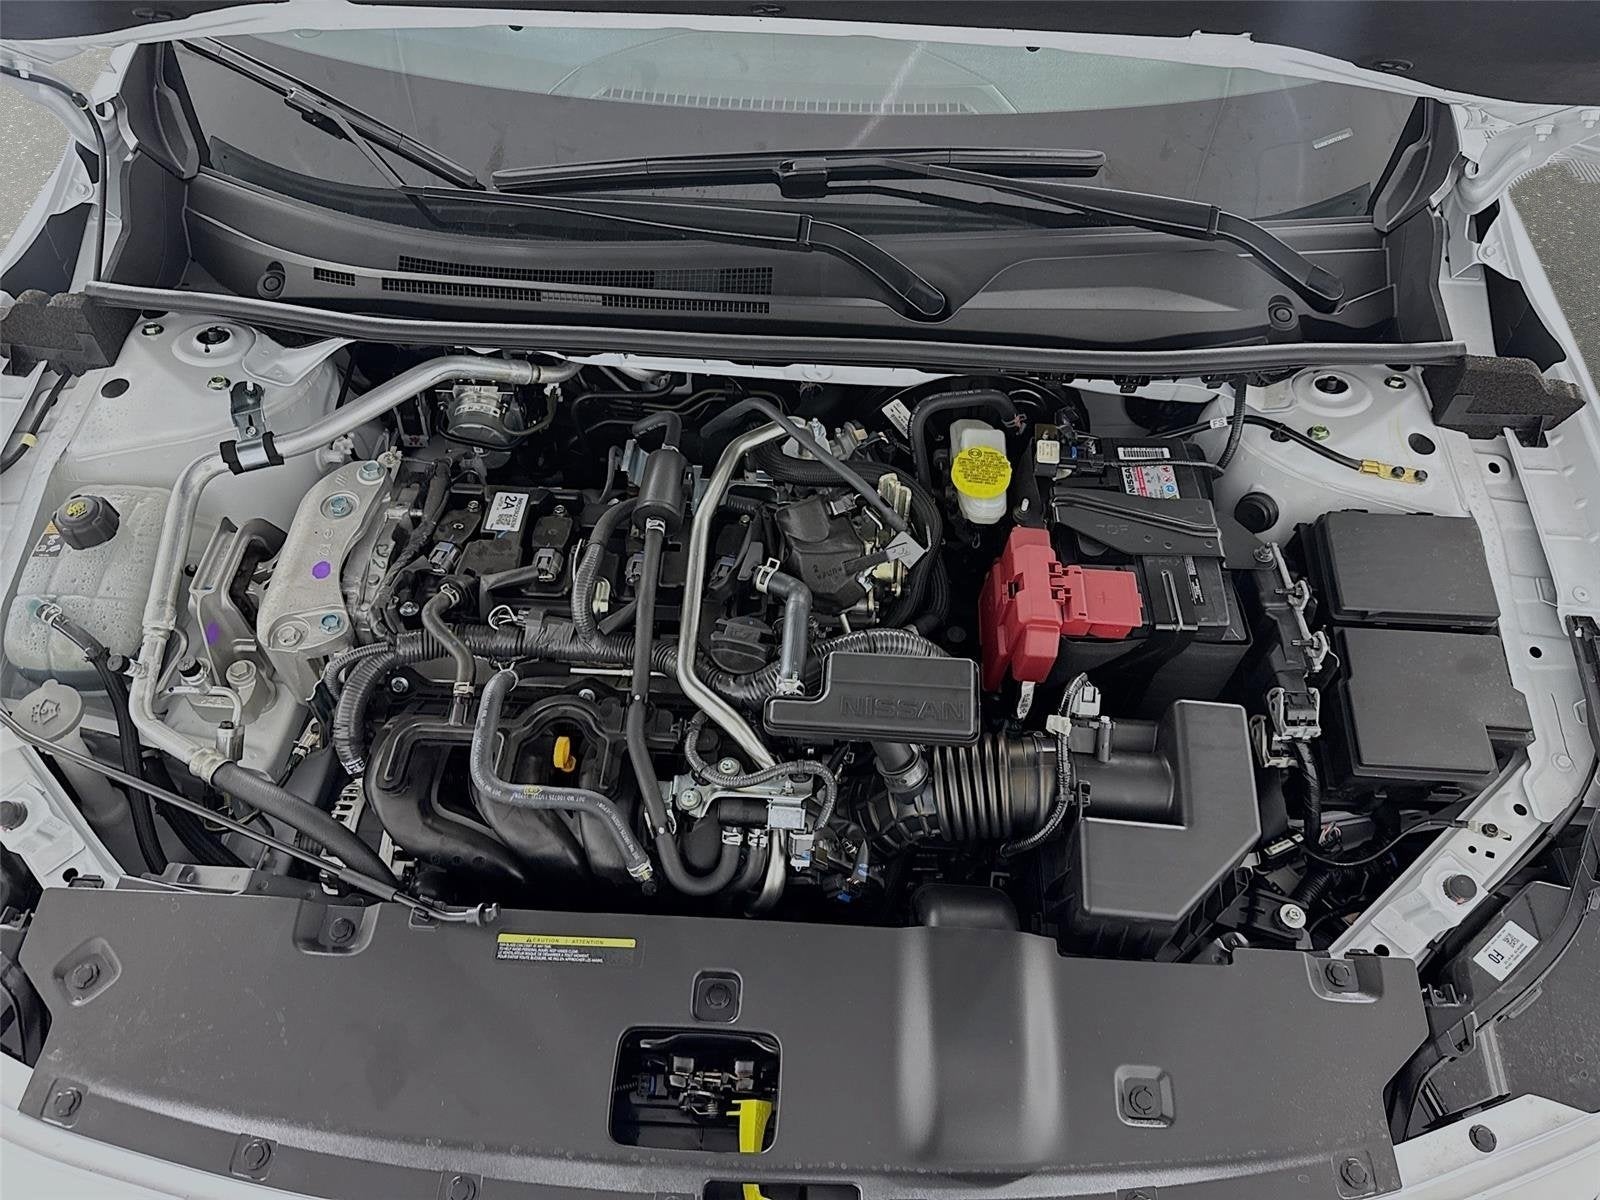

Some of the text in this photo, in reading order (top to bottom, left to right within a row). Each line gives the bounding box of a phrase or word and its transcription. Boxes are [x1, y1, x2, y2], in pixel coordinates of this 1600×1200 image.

[1125, 467, 1136, 494] NISSA
[502, 495, 518, 510] 2A
[840, 695, 966, 721] NISSAN
